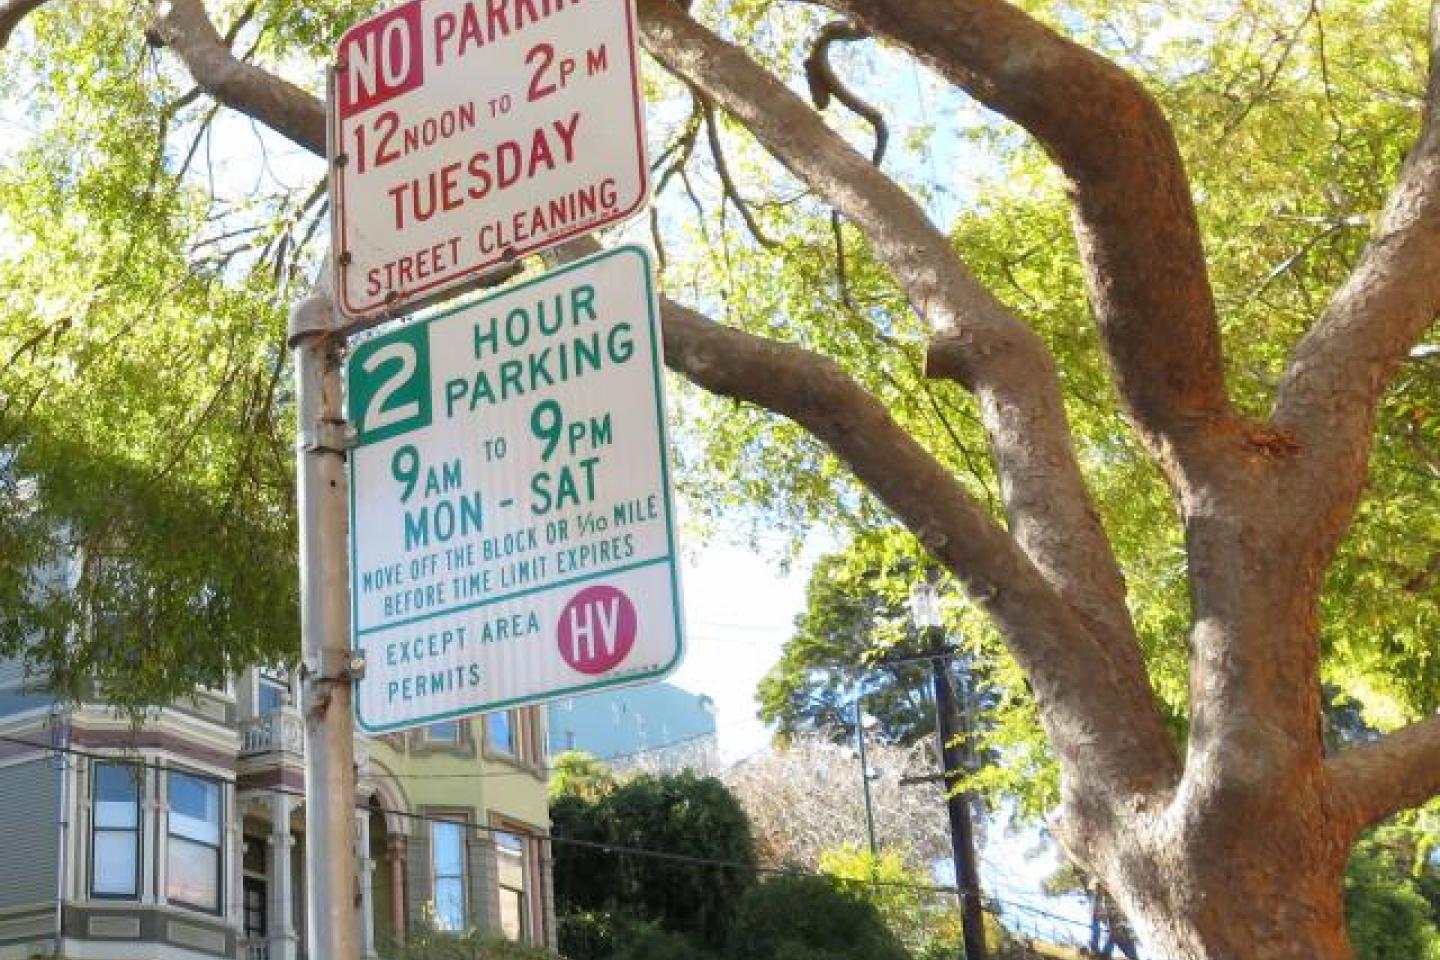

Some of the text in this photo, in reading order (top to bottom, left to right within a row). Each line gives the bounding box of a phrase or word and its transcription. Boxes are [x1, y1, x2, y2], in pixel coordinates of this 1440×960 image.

[348, 0, 578, 105] NO PARK
[489, 95, 511, 118] TO
[388, 112, 580, 230] TUESDAY
[368, 178, 618, 296] STREET CLEANING
[361, 284, 597, 432] 2 HOUR
[445, 322, 635, 417] PARKING
[483, 437, 507, 462] TO
[362, 563, 402, 593] MOVE
[411, 554, 438, 580] OFF
[445, 543, 476, 571] THE
[483, 527, 538, 561] BLOCK
[546, 520, 568, 545] OR
[613, 496, 658, 527] MILE
[404, 491, 483, 552] MON
[531, 457, 600, 516] SAT
[384, 534, 634, 616] BEFORE TIME LIMIT EXPIRES
[386, 611, 541, 665] EXCEPT AREA
[570, 598, 620, 661] HV
[388, 664, 481, 703] PERMITS
